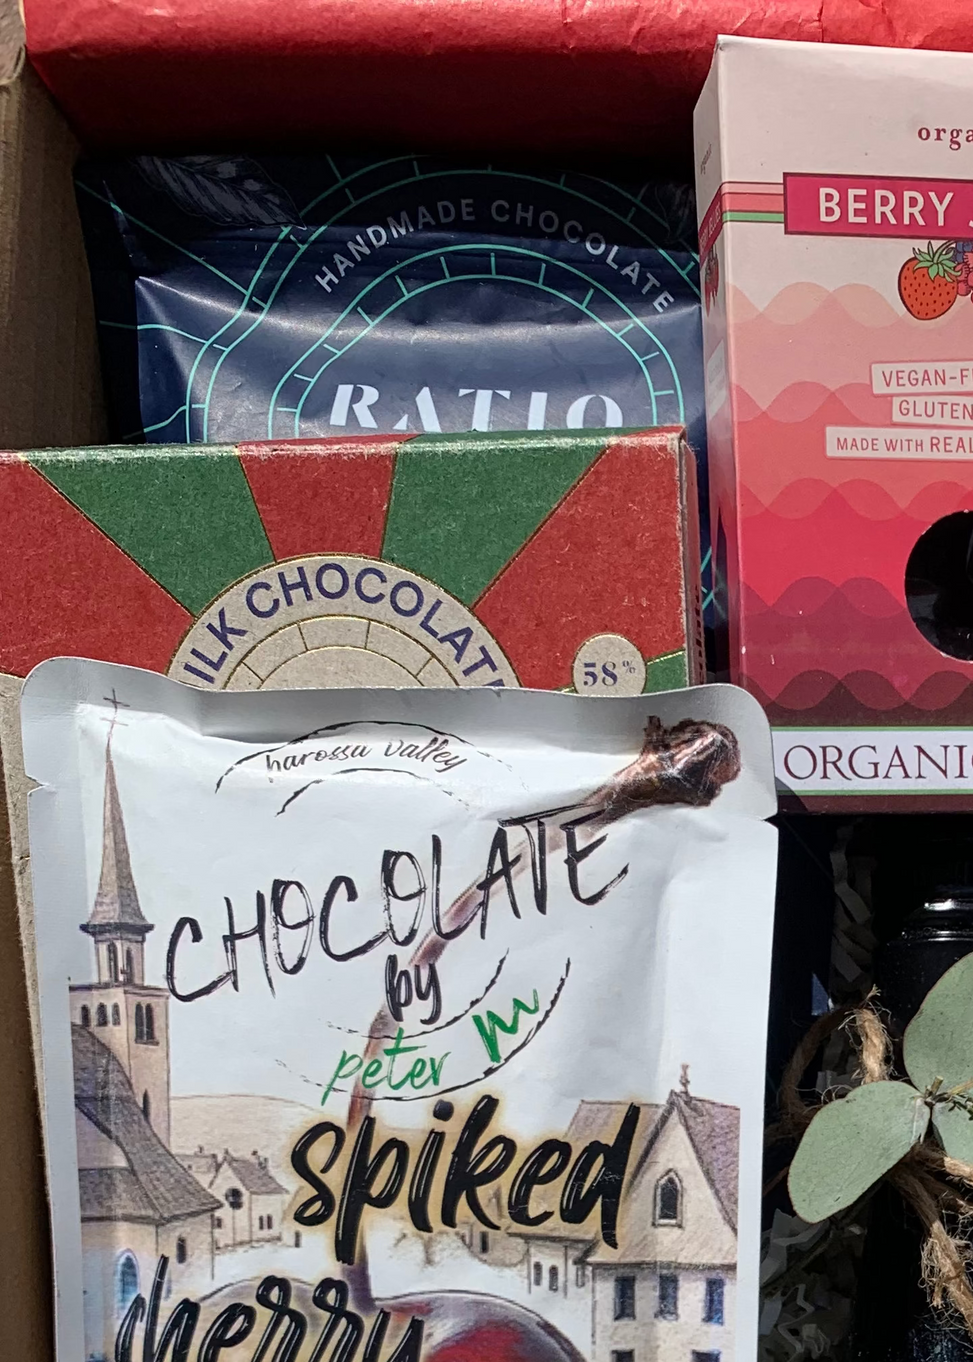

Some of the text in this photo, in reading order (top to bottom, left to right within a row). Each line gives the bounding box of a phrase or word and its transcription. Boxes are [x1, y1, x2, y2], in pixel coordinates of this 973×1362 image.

[818, 187, 954, 226] BERRY
[314, 199, 476, 293] HANDMADE
[490, 200, 675, 314] CHOCOLATE
[329, 384, 623, 433] RATIO
[836, 436, 881, 452] MADE
[884, 437, 924, 452] WITH
[183, 561, 507, 688] ILK CHOCOLAT
[584, 659, 637, 687] 58%
[384, 736, 468, 773] valley
[166, 802, 629, 1002] CHOCOLATE
[385, 954, 443, 1025] by
[321, 1029, 452, 1106] peter
[290, 1094, 640, 1265] spiked
